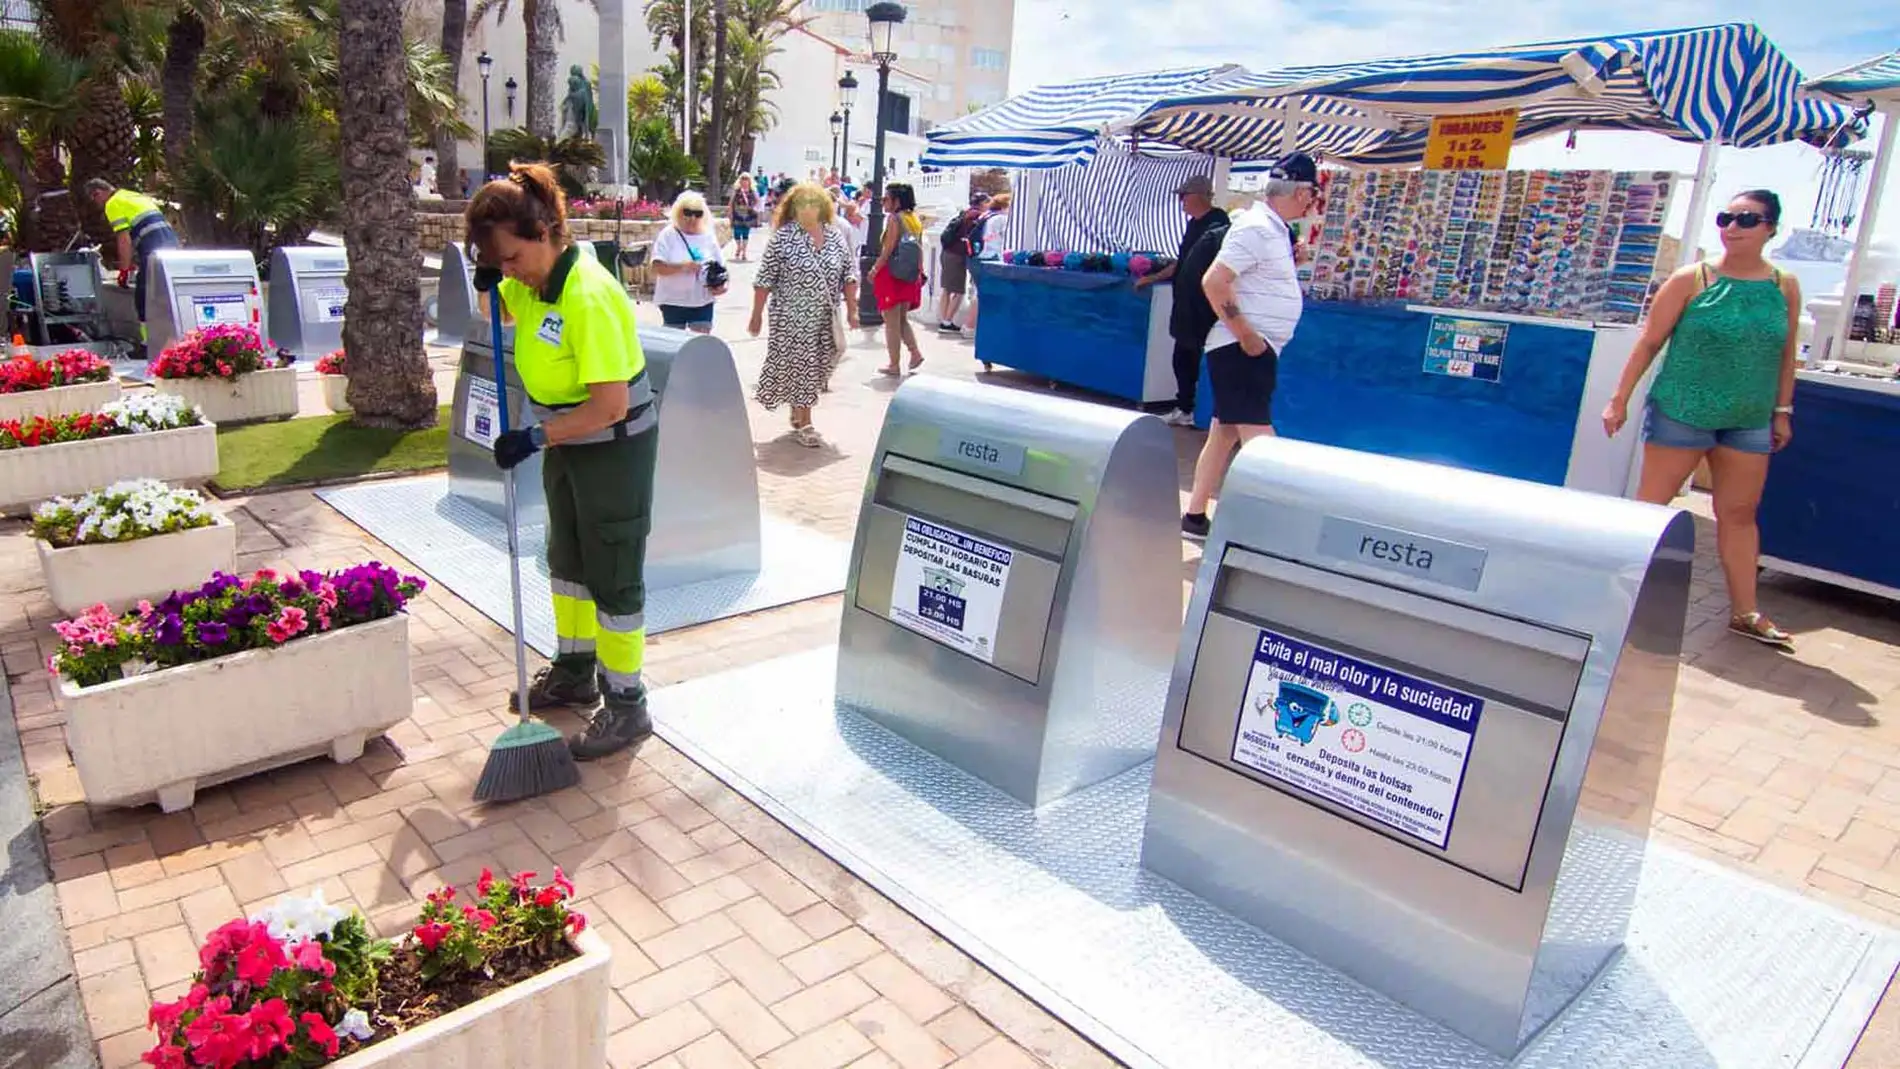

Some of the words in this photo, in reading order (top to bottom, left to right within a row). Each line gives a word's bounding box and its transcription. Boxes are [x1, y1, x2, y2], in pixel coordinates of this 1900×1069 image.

[958, 440, 998, 463] resta
[903, 544, 944, 566] DEPOSITAR
[945, 560, 961, 573] LAS
[962, 566, 1001, 588] BASURAS
[905, 533, 937, 550] CUMPLA
[940, 545, 950, 555] SU
[951, 549, 989, 570] HORARIO
[990, 563, 1003, 575] EN
[973, 543, 1010, 563] BENEFICIO
[1359, 535, 1433, 569] resta
[1260, 636, 1291, 662] Evita
[1293, 651, 1309, 667] el
[1309, 656, 1338, 677] mal
[1340, 665, 1370, 687] olor
[1370, 676, 1381, 694] y
[1383, 677, 1398, 697] la
[1400, 686, 1474, 721] suciedad
[1319, 748, 1360, 773] Deposita
[1362, 765, 1378, 779] las
[1379, 772, 1413, 793] bolsas
[1369, 748, 1392, 761] Hasta
[1286, 752, 1326, 774] cerradas
[1327, 767, 1334, 777] y
[1335, 772, 1366, 790] dentro
[1368, 784, 1384, 797] del
[1386, 792, 1445, 820] contenedor
